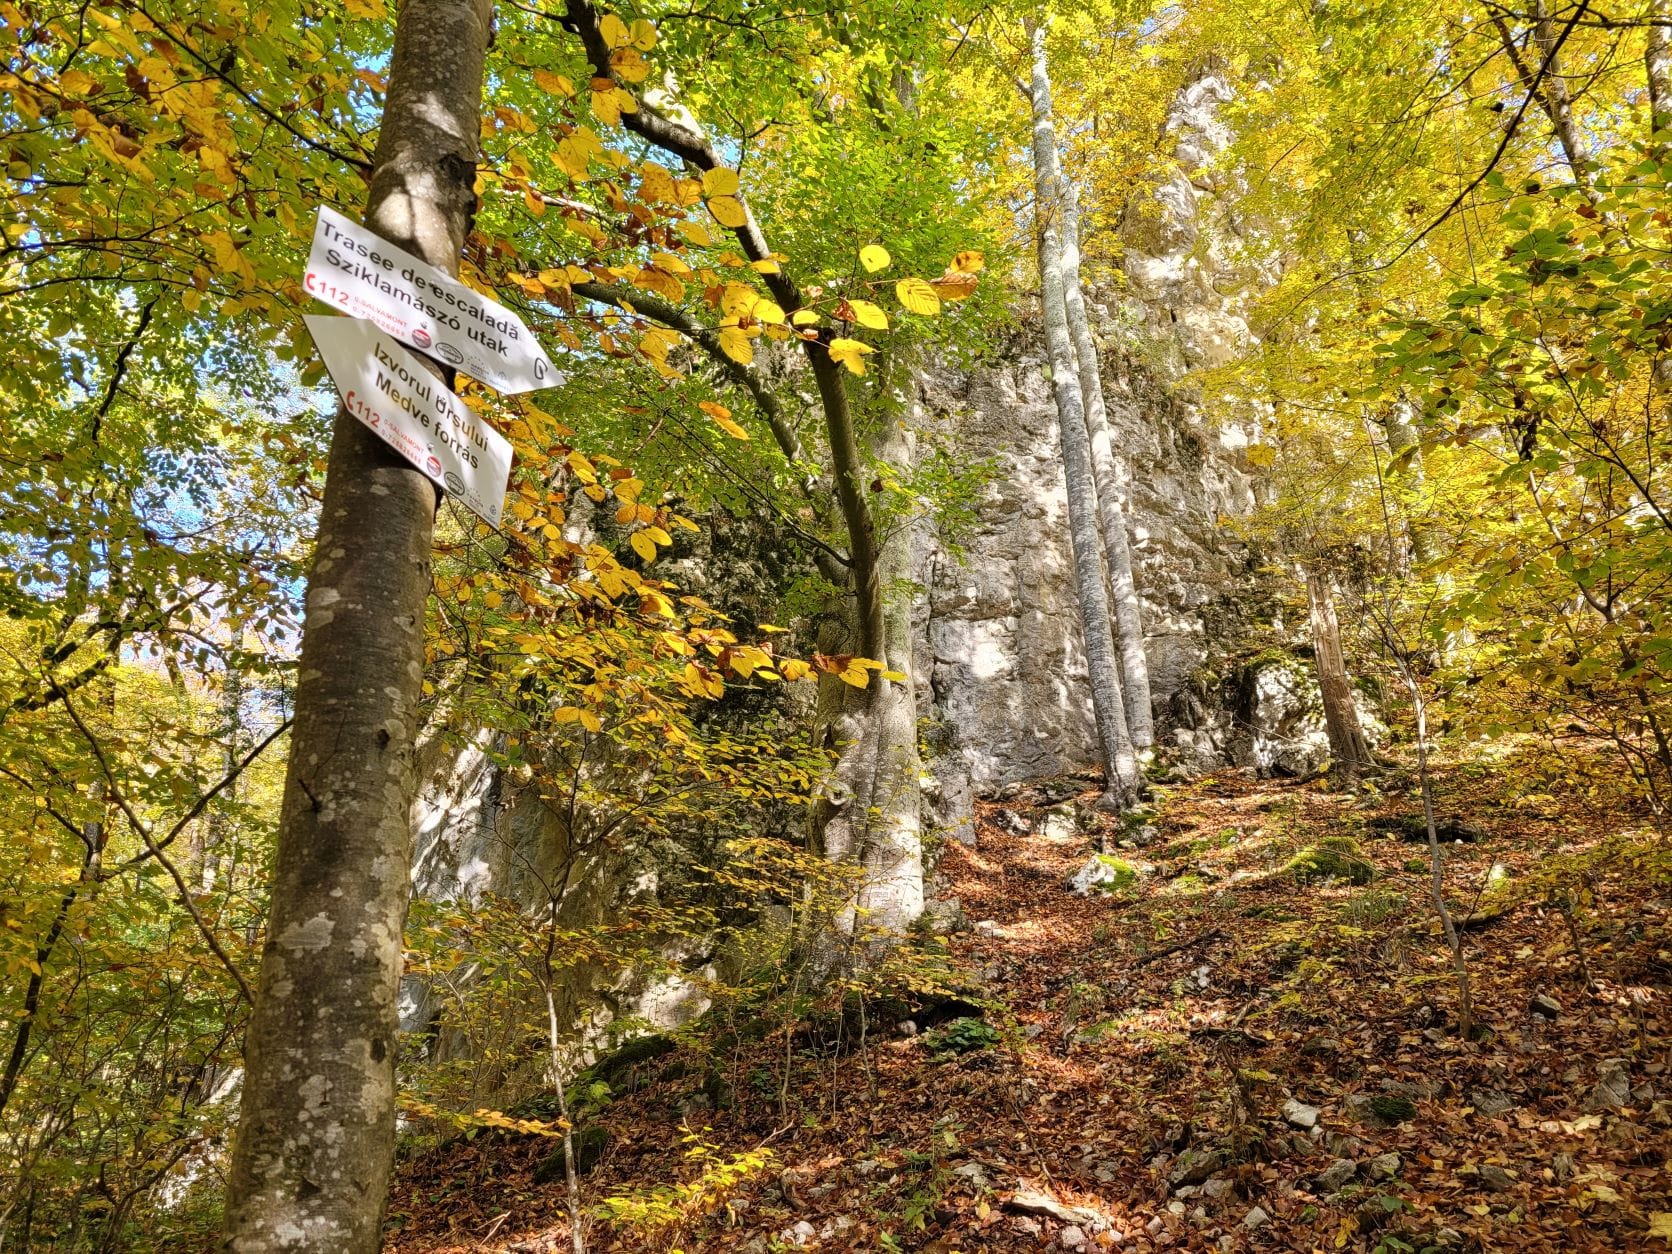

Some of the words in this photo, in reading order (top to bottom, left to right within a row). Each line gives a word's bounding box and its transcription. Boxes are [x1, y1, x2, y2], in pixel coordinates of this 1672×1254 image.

[320, 279, 350, 305] 112
[321, 219, 394, 272] Trasee
[402, 266, 427, 290] de
[433, 284, 519, 341] escaladă
[325, 248, 461, 331] Sziklamászó
[467, 325, 508, 357] utak
[374, 341, 431, 402] Izvorul
[355, 400, 381, 429] 112
[375, 370, 431, 428] Medve
[435, 421, 479, 470] forrás
